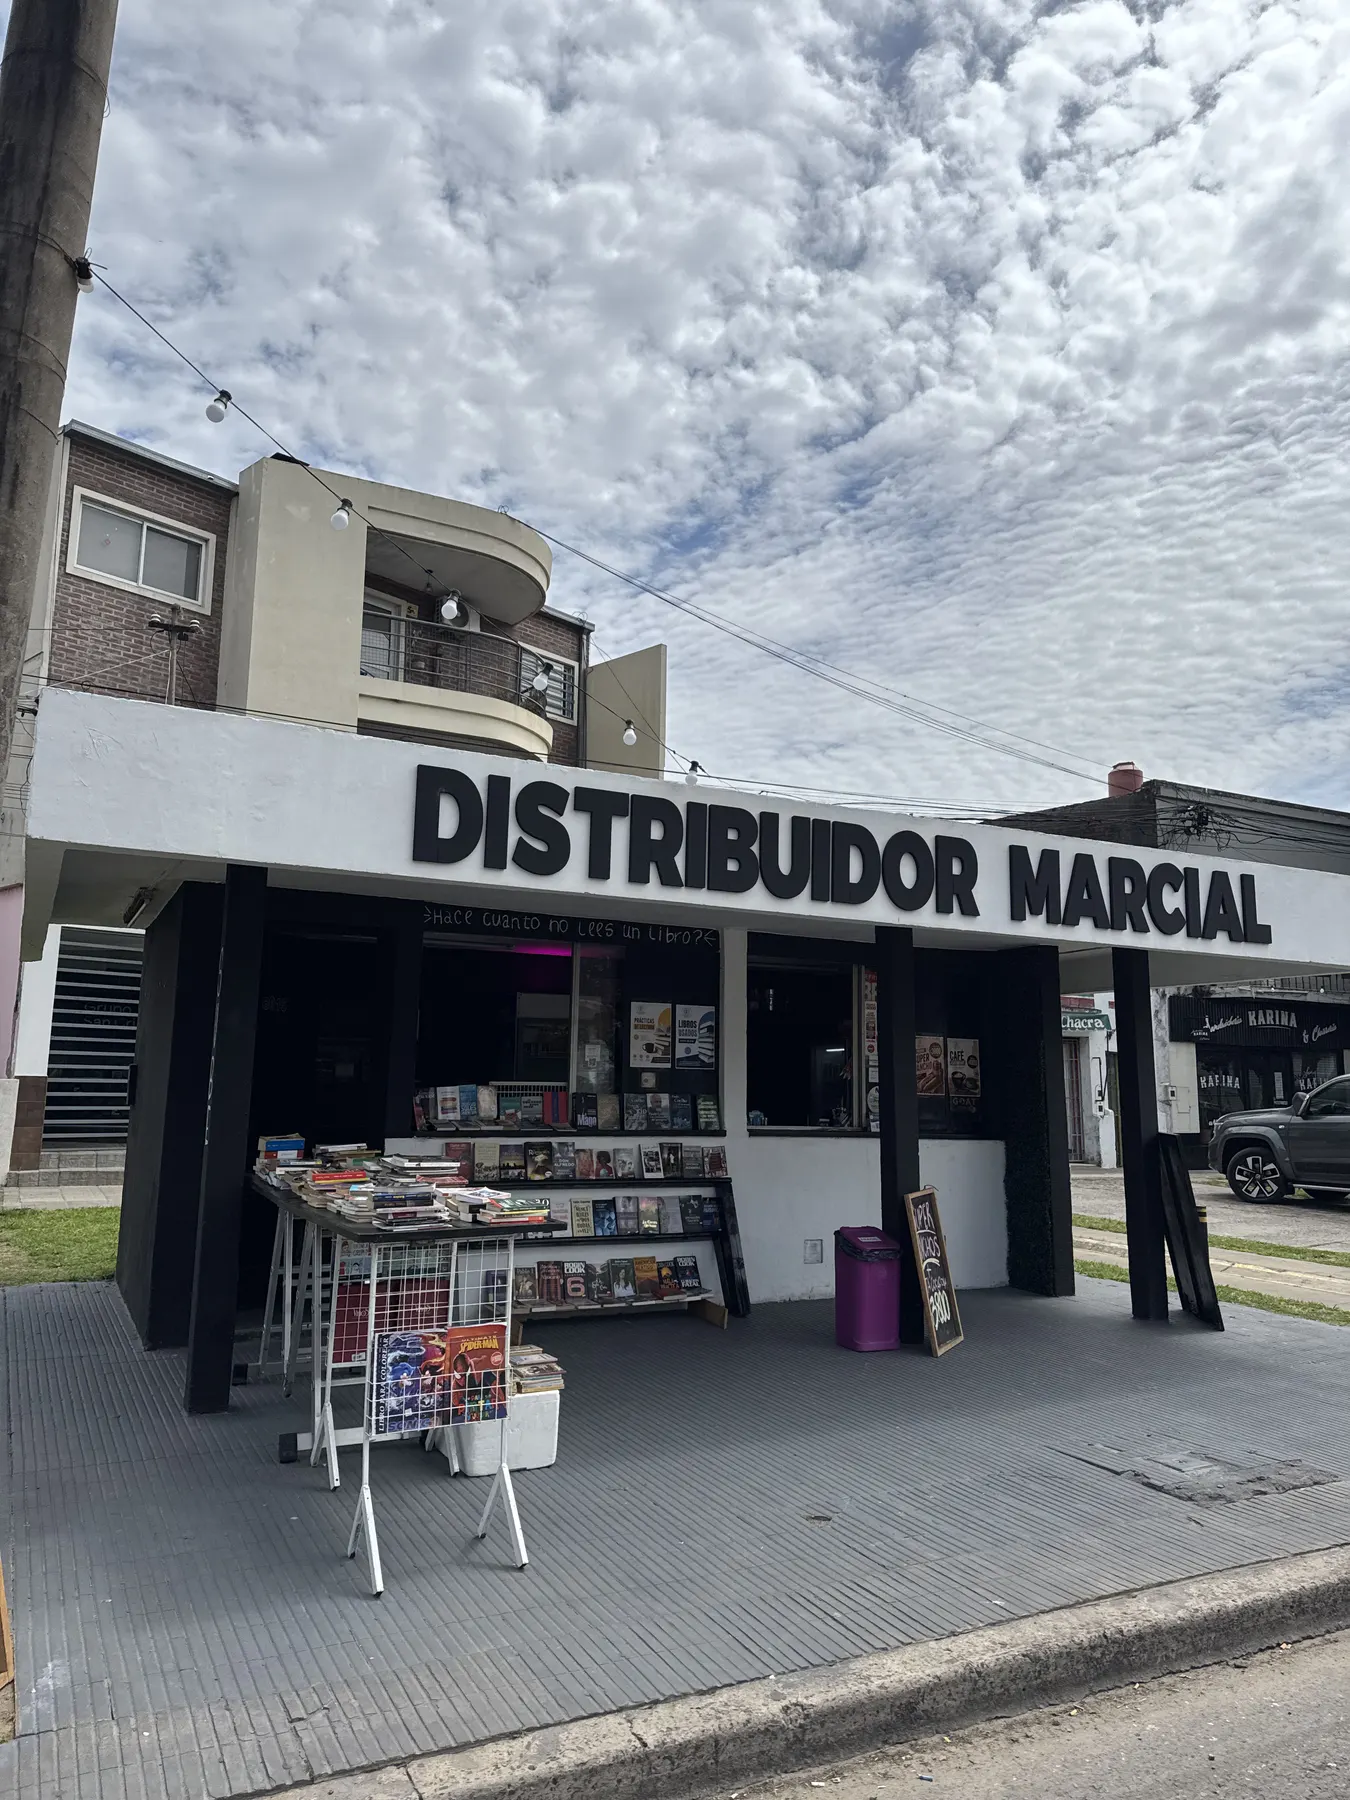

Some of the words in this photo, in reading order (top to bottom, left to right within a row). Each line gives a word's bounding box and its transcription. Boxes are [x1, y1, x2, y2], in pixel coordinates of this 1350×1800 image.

[412, 763, 981, 918] DISTRIBUIDOR
[1009, 844, 1272, 944] MARCIAL
[483, 910, 540, 930] cuanto
[549, 917, 568, 933] no
[621, 924, 640, 941] un
[678, 1020, 697, 1029] LIBROS
[1062, 1016, 1105, 1029] Chacra
[1248, 1010, 1298, 1028] KARINA
[678, 1029, 698, 1038] USADOS
[577, 1114, 597, 1127] Mago
[567, 1277, 585, 1297] 6
[459, 1338, 499, 1354] SPIDER-MAN
[381, 1338, 389, 1381] COLOREAR
